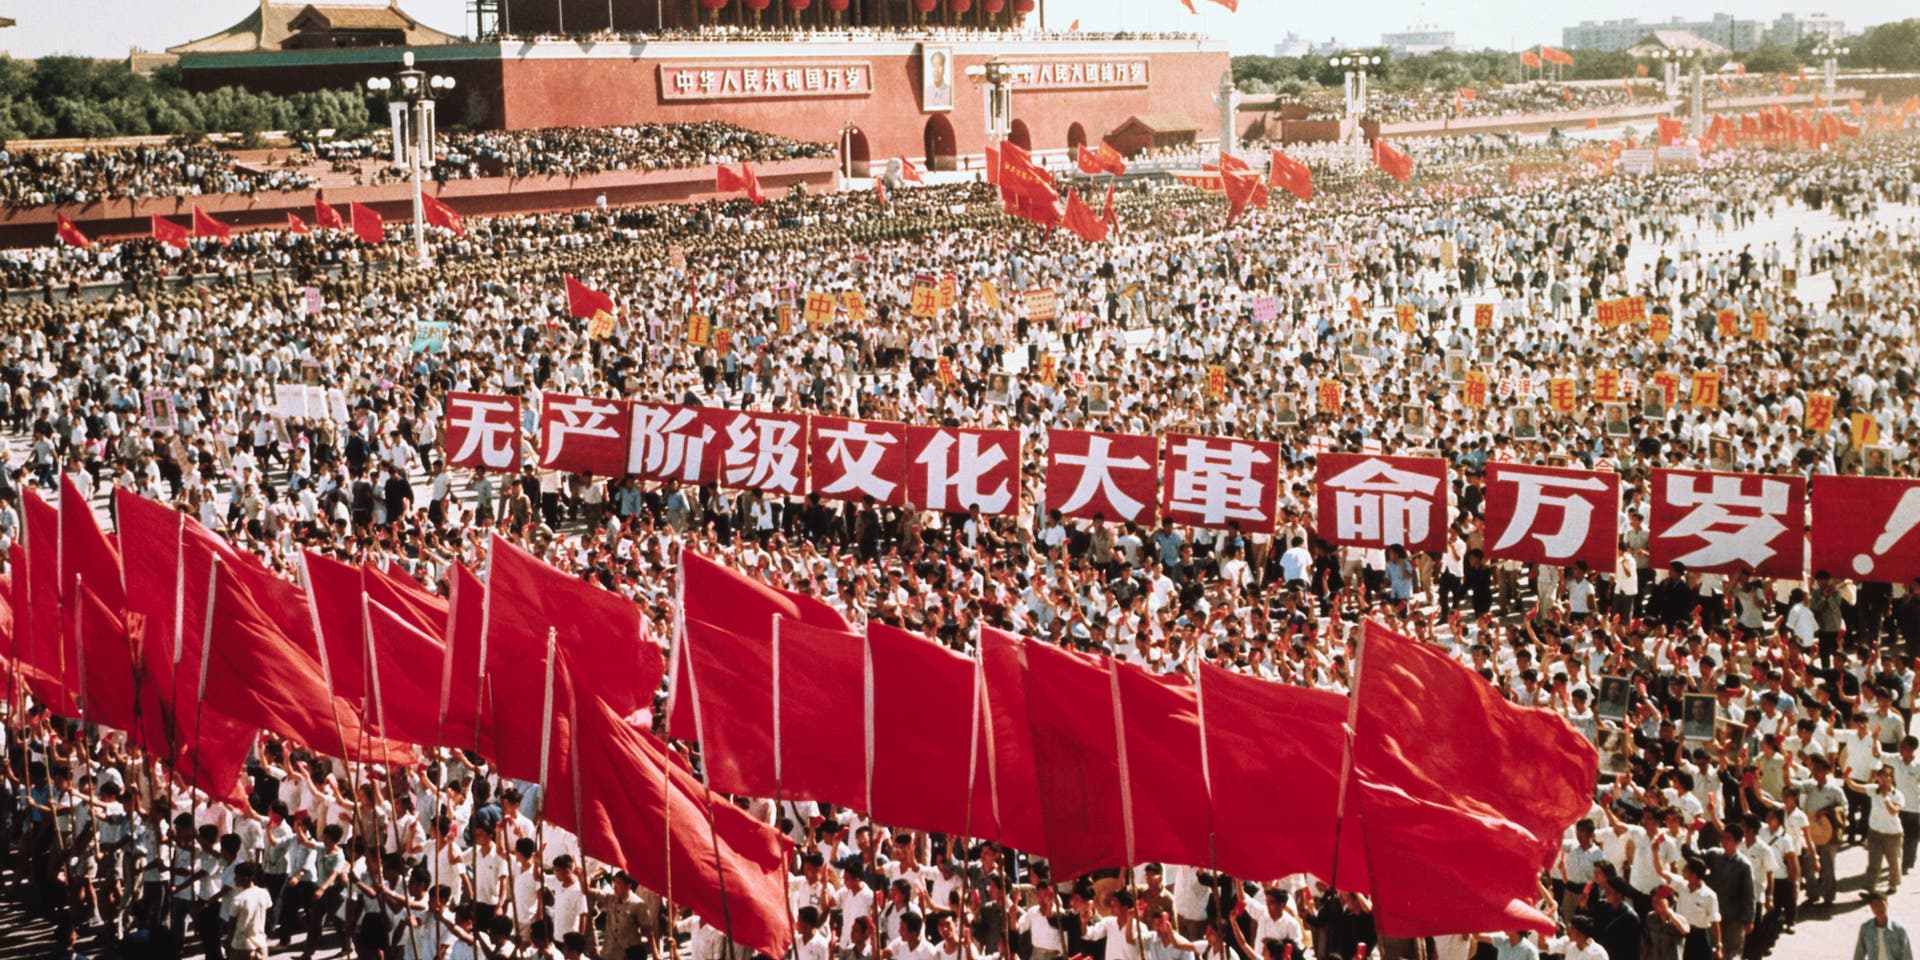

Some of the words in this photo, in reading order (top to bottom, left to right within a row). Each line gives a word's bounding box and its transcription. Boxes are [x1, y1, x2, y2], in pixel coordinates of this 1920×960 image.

[677, 68, 860, 93] 中华人民共和国万岁
[809, 294, 831, 319] 中
[850, 293, 865, 318] 央
[916, 289, 935, 314] 决
[1400, 306, 1414, 329] 大
[1753, 315, 1766, 338] 万
[1042, 356, 1055, 382] 大
[1211, 368, 1224, 395] 的
[1552, 381, 1573, 410] 毛
[1597, 370, 1616, 400] 主
[1695, 376, 1716, 403] 万
[1810, 397, 1830, 428] 岁
